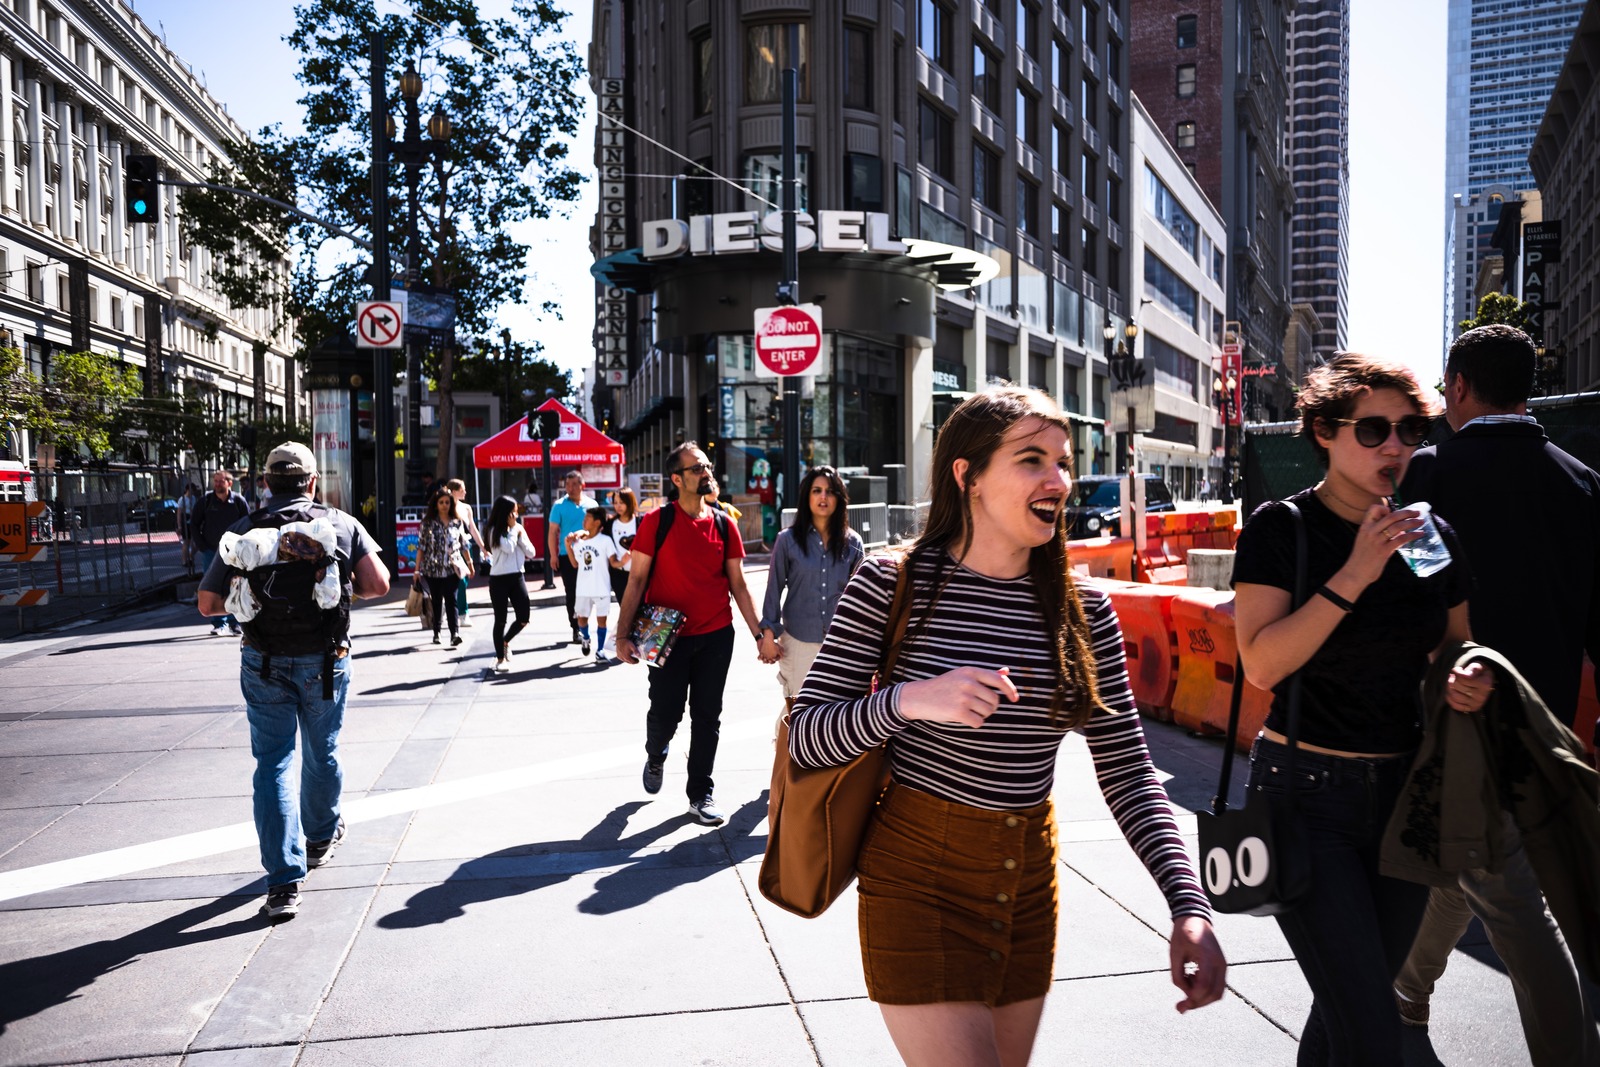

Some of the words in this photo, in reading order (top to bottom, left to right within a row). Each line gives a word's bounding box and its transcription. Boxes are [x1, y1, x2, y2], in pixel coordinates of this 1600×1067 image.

[642, 211, 909, 260] DIESEL
[1527, 233, 1558, 241] O'FARRELL
[606, 199, 627, 368] CALORNIA
[1525, 251, 1543, 327] PARK
[787, 320, 810, 332] NOT
[770, 349, 807, 363] ENTER
[490, 455, 514, 463] LOCALLY
[0, 524, 22, 536] UR
